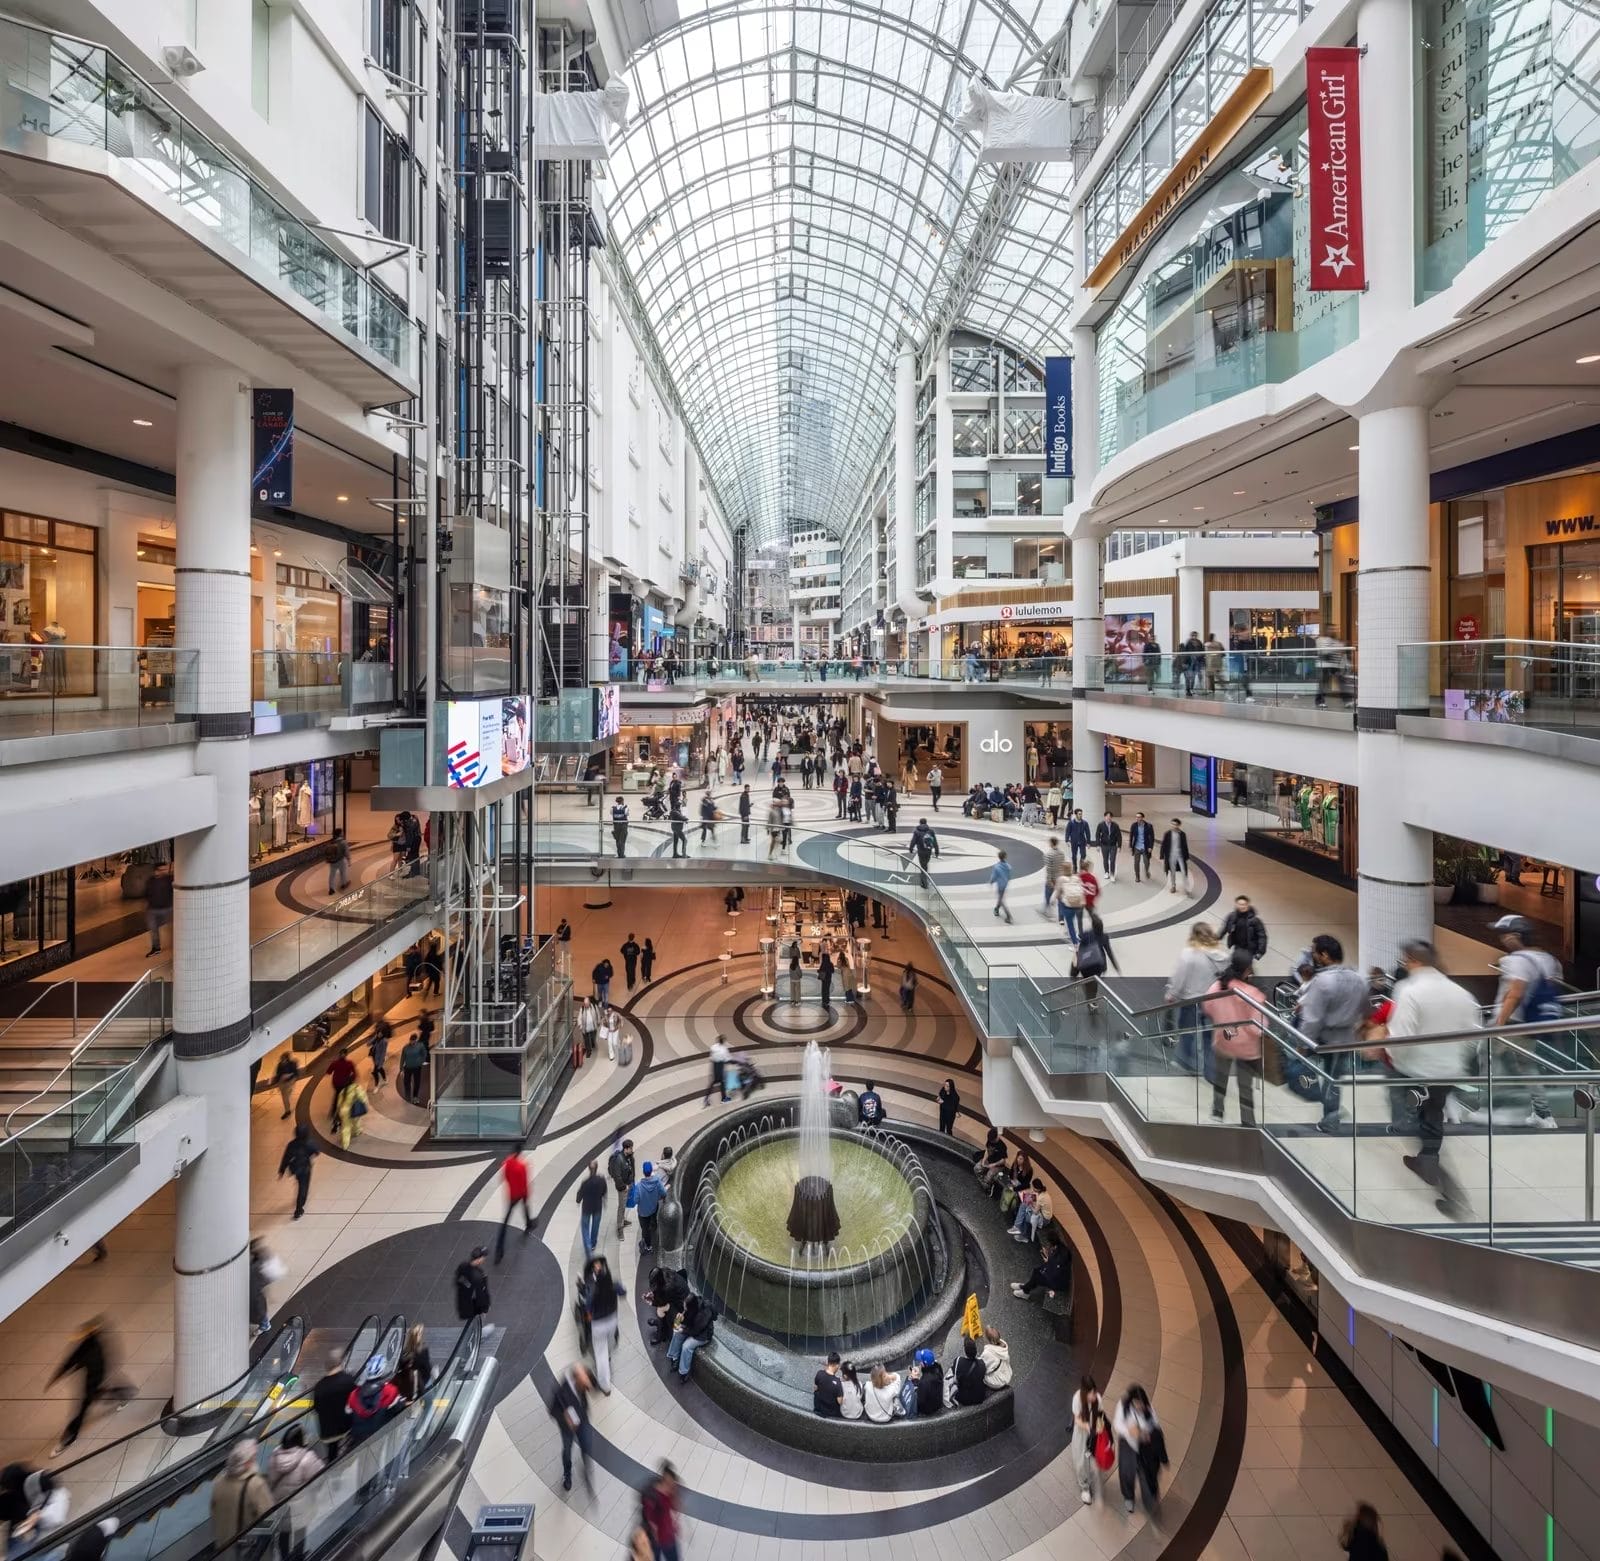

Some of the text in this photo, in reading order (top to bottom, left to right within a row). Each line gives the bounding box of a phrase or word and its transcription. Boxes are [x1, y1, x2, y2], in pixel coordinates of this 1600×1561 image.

[1119, 146, 1211, 266] IMAGINATION
[1049, 395, 1069, 473] Indigo Books
[1015, 605, 1062, 617] lululemon
[980, 729, 1013, 753] alo
